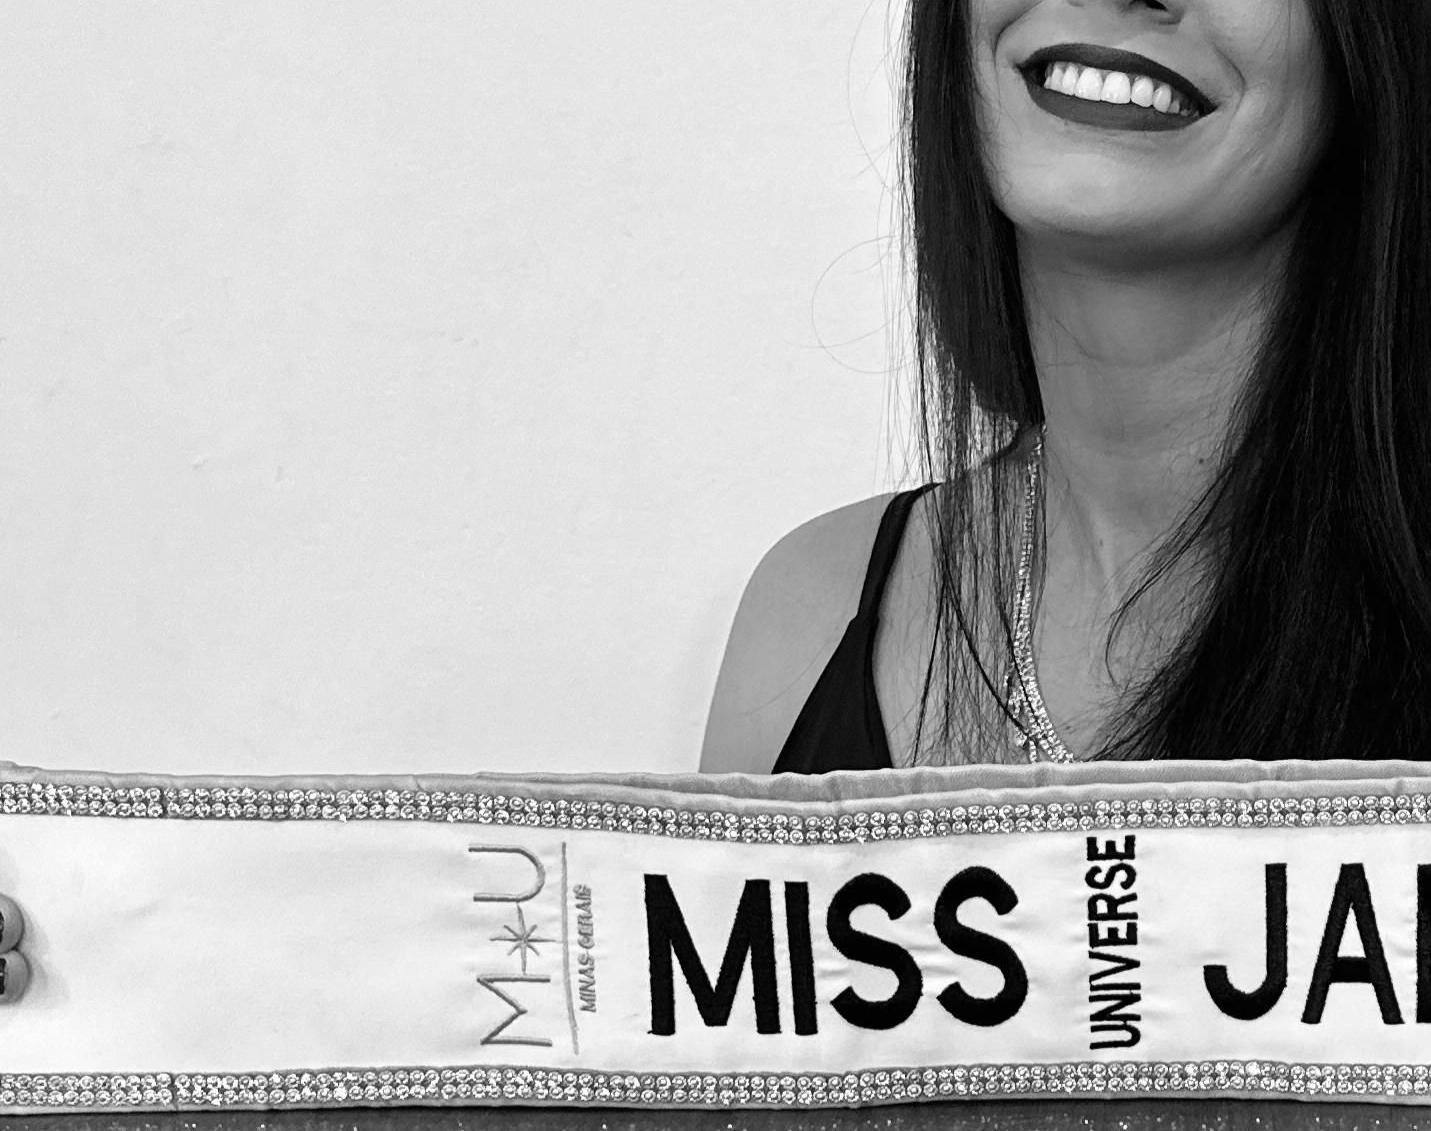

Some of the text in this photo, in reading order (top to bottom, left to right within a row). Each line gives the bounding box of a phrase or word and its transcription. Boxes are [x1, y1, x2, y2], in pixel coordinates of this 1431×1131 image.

[573, 884, 597, 1013] MINAS GERAIS
[643, 865, 1029, 1037] MISS
[1085, 834, 1142, 1050] UNIVERSE
